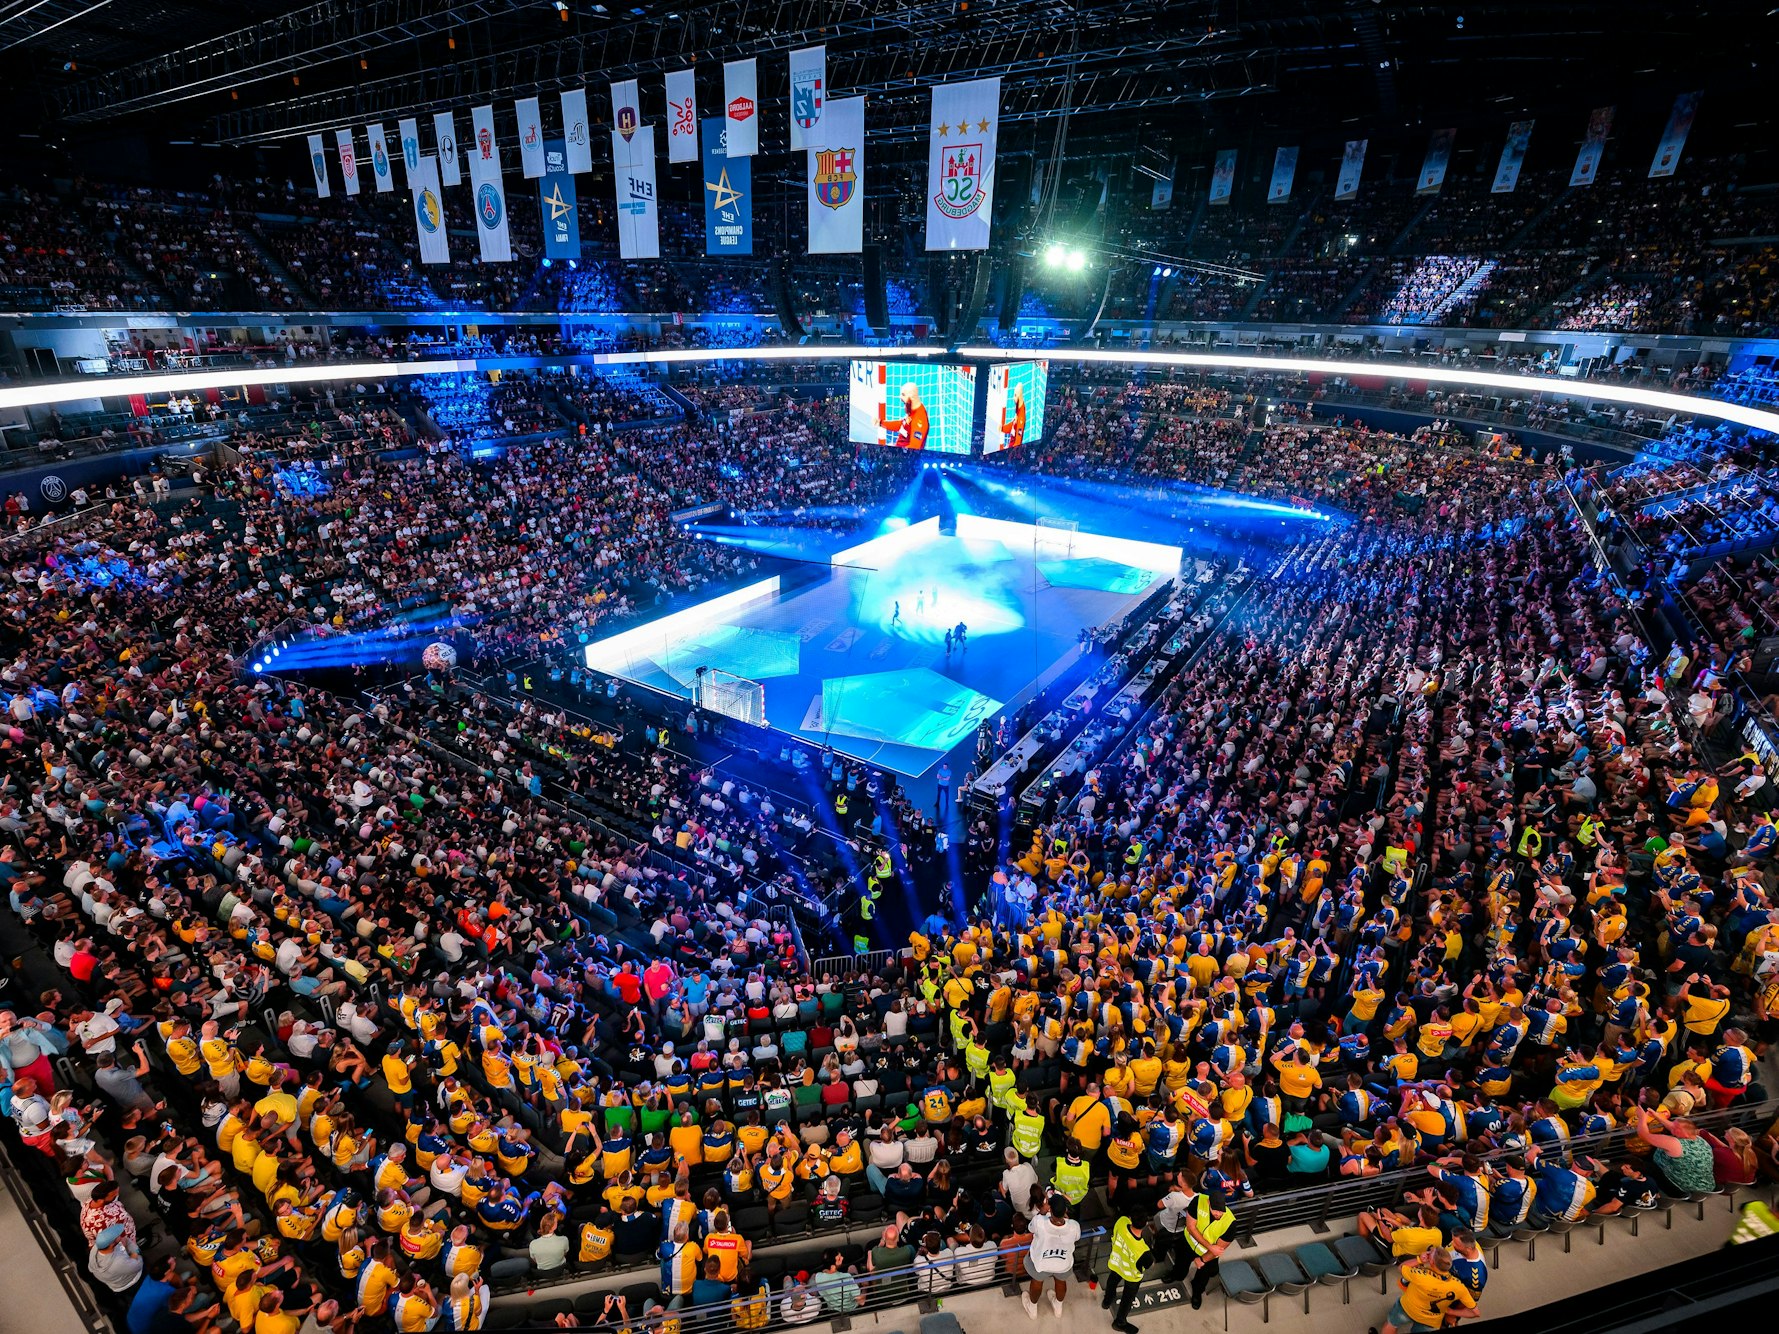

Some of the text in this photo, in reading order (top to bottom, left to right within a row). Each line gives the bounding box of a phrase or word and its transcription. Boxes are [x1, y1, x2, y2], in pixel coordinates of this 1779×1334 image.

[550, 1011, 562, 1026] 11
[729, 1018, 747, 1026] GETEC
[738, 1098, 758, 1107] GETEC
[768, 1096, 790, 1105] GETEC
[929, 1096, 944, 1108] 24
[819, 1209, 843, 1217] GETEC
[1043, 1249, 1067, 1259] EHF
[1156, 1288, 1181, 1303] 218
